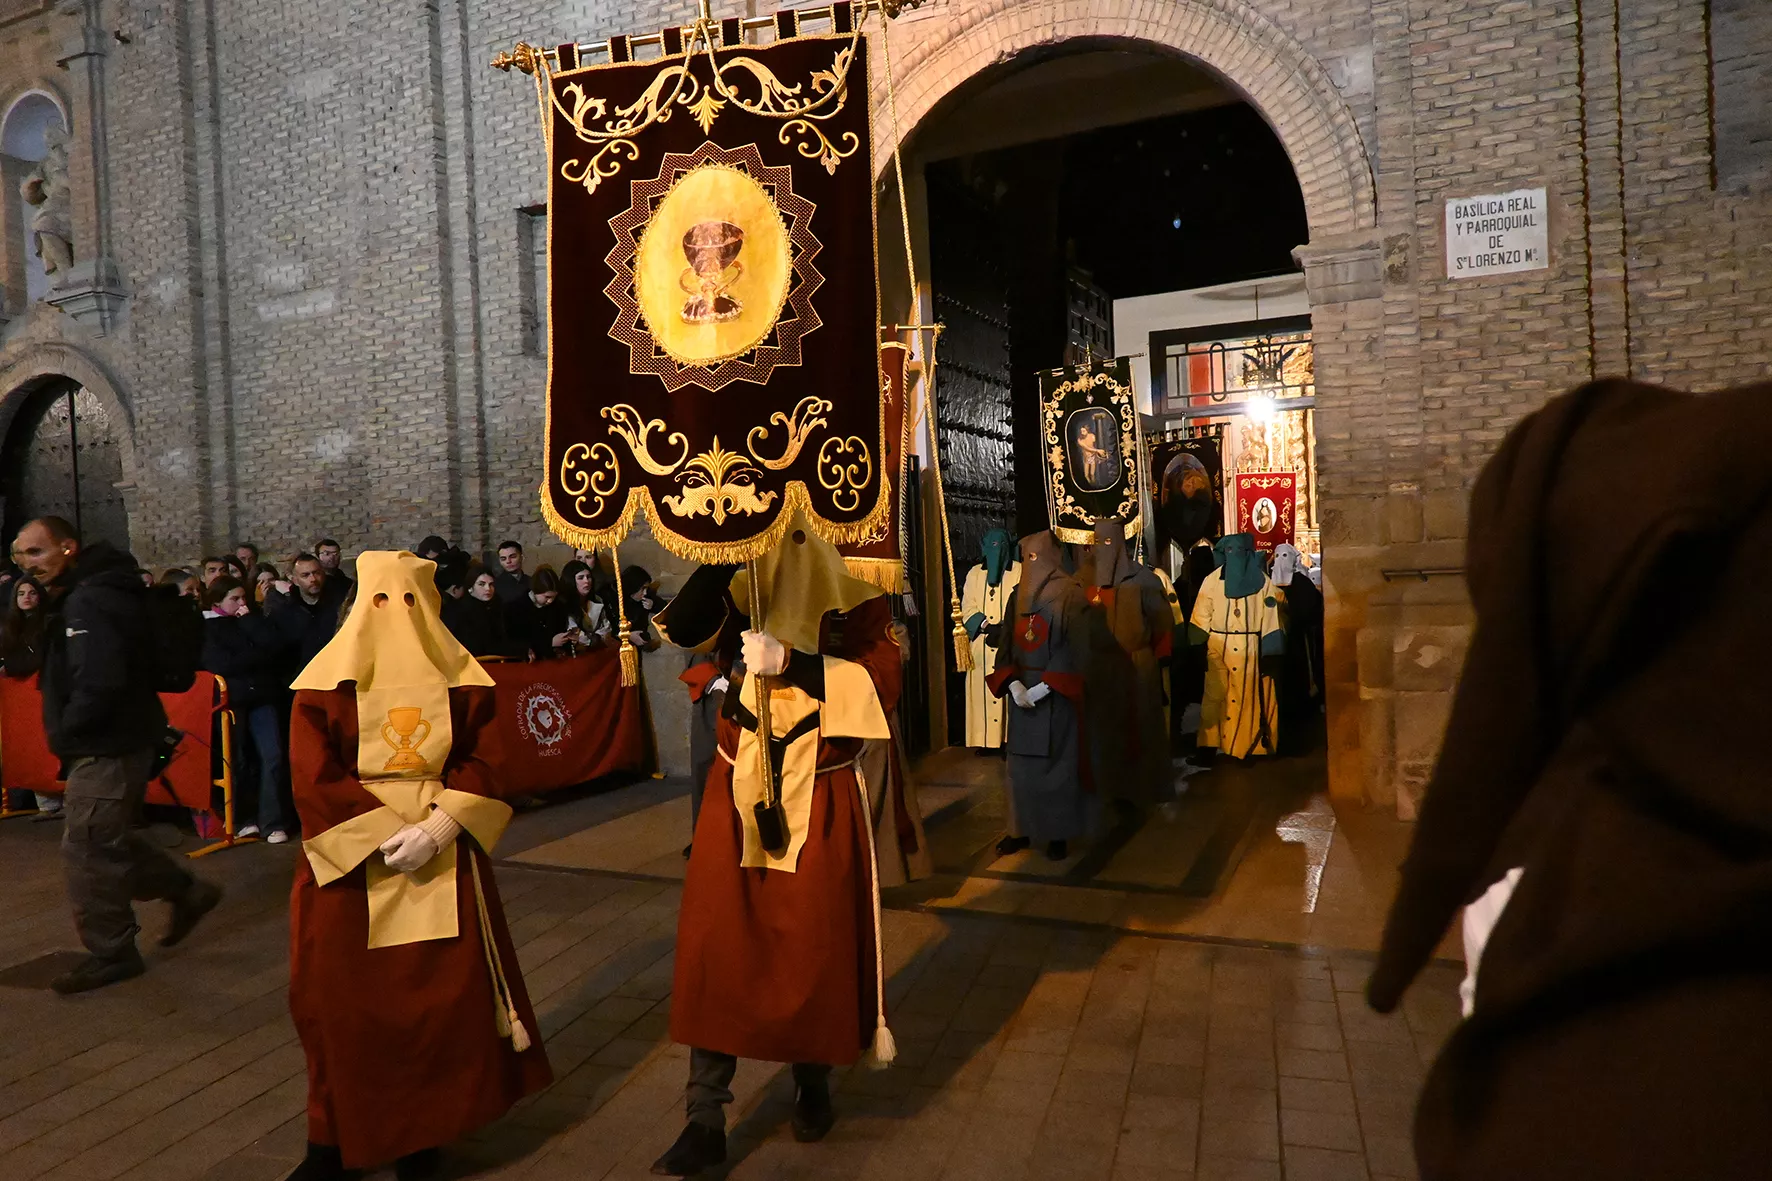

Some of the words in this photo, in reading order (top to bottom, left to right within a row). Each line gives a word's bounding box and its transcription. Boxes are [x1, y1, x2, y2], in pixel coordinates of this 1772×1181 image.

[1508, 196, 1536, 212] REAL
[1456, 223, 1462, 235] Y
[1467, 213, 1537, 234] PARROQUIAL
[1489, 234, 1504, 249] DE
[1468, 250, 1521, 268] LORENZO
[524, 685, 533, 695] LA
